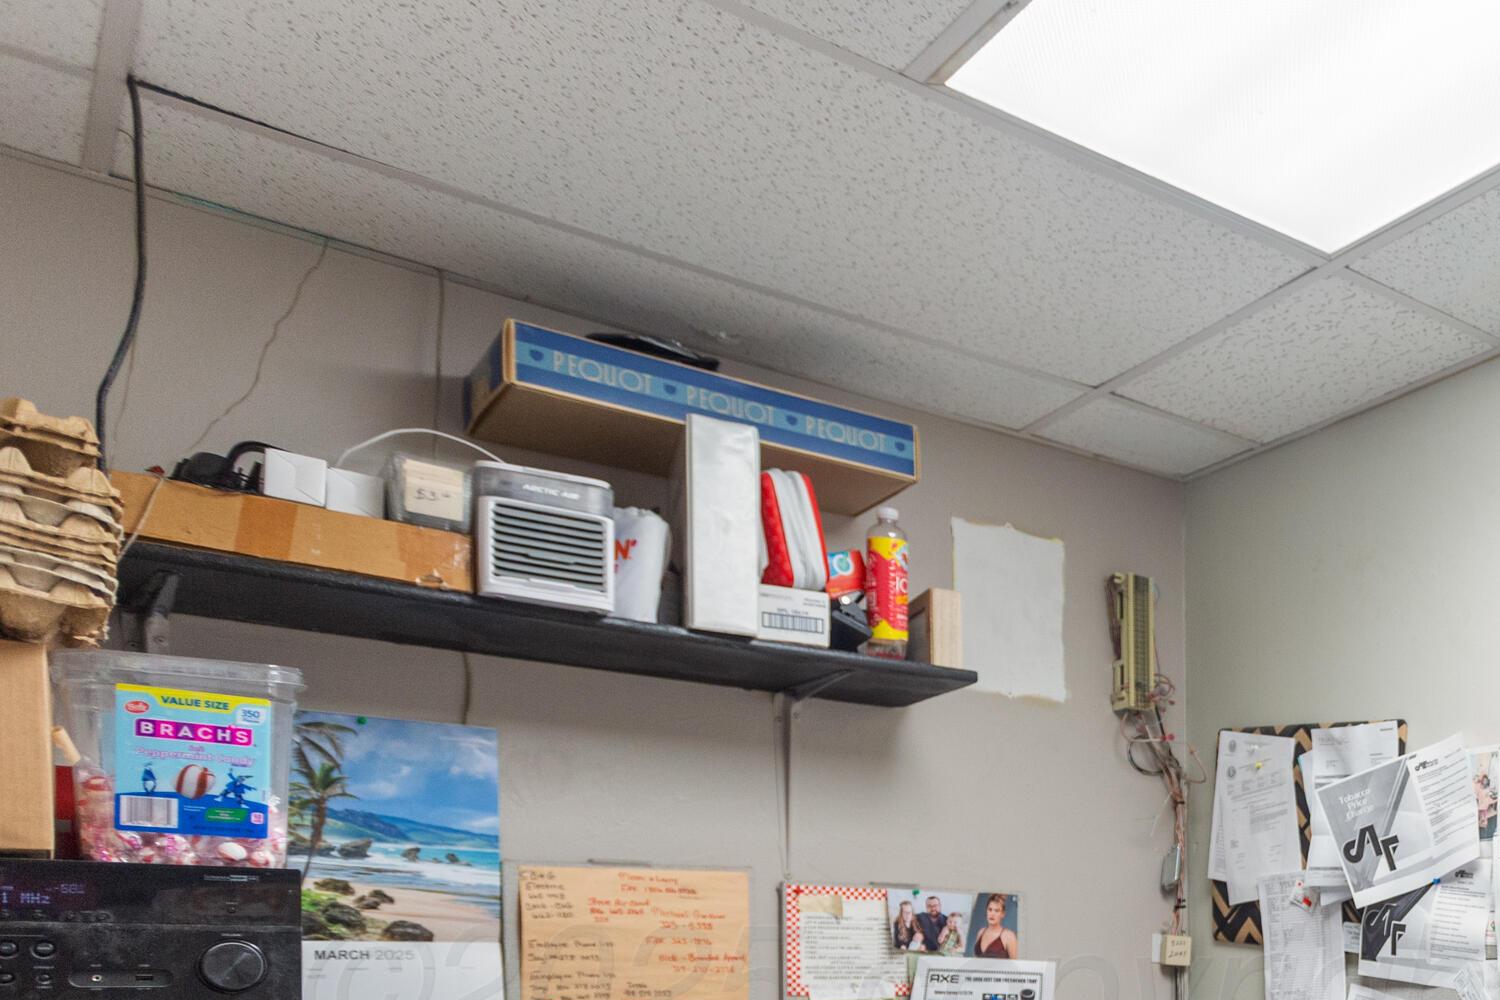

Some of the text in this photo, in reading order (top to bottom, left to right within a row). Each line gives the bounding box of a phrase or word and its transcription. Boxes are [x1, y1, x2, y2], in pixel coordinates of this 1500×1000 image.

[553, 350, 886, 451] PEQUOT PEQUOT PEQUOT
[161, 695, 229, 710] VALUE SIZE
[241, 709, 260, 718] 350
[314, 949, 416, 961] MARCH 2025
[929, 973, 960, 984] AXE
